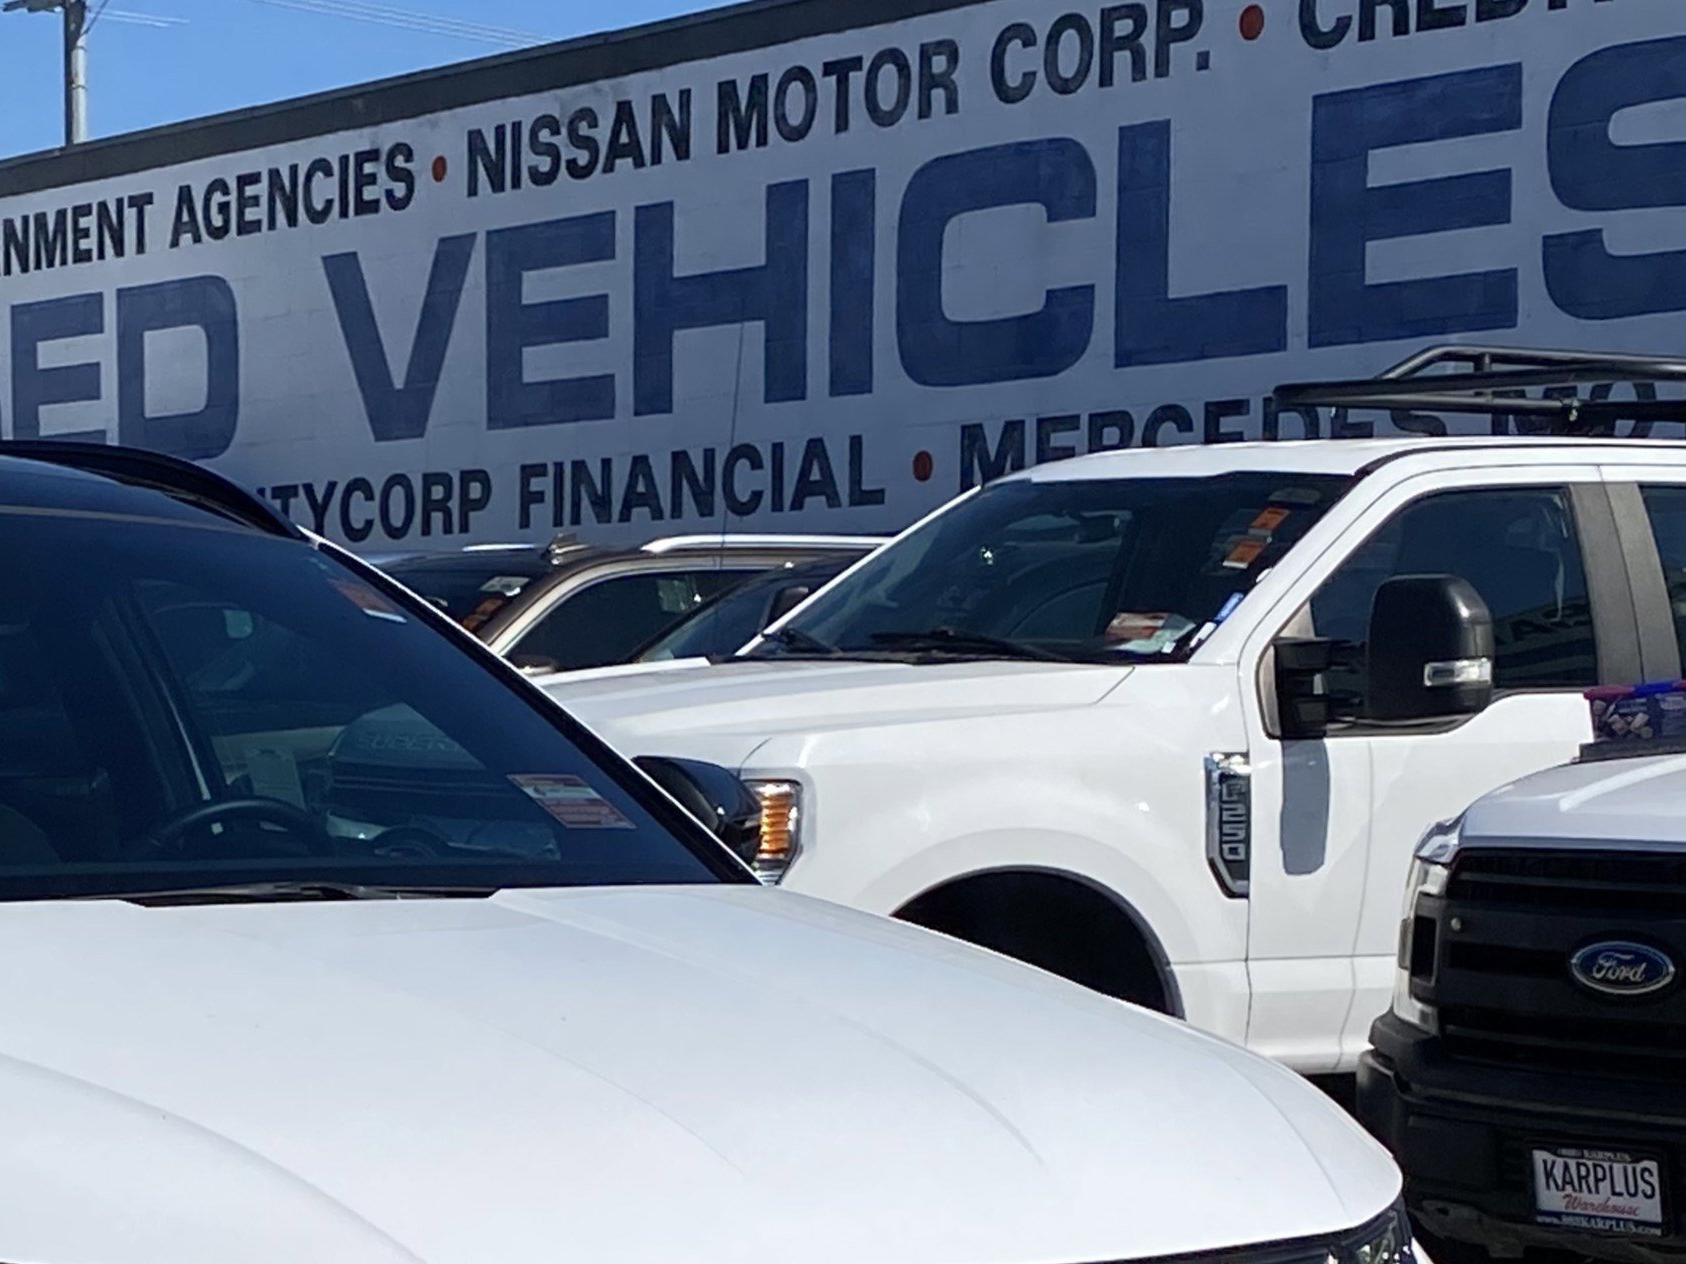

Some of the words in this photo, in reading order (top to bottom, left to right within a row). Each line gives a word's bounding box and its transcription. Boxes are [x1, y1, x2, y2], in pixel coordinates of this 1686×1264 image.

[466, 87, 692, 198] NISSAN
[715, 38, 960, 155] MOTOR
[990, 0, 1211, 104] CORP.
[169, 142, 415, 250] AGENCIES
[321, 34, 1686, 443] VEHICLES
[256, 468, 493, 543] TYCORP
[518, 434, 886, 530] FINANCIAL
[1592, 951, 1648, 983] Ford
[1542, 1158, 1655, 1200] KARPLUS
[1562, 1193, 1642, 1217] Warehouse
